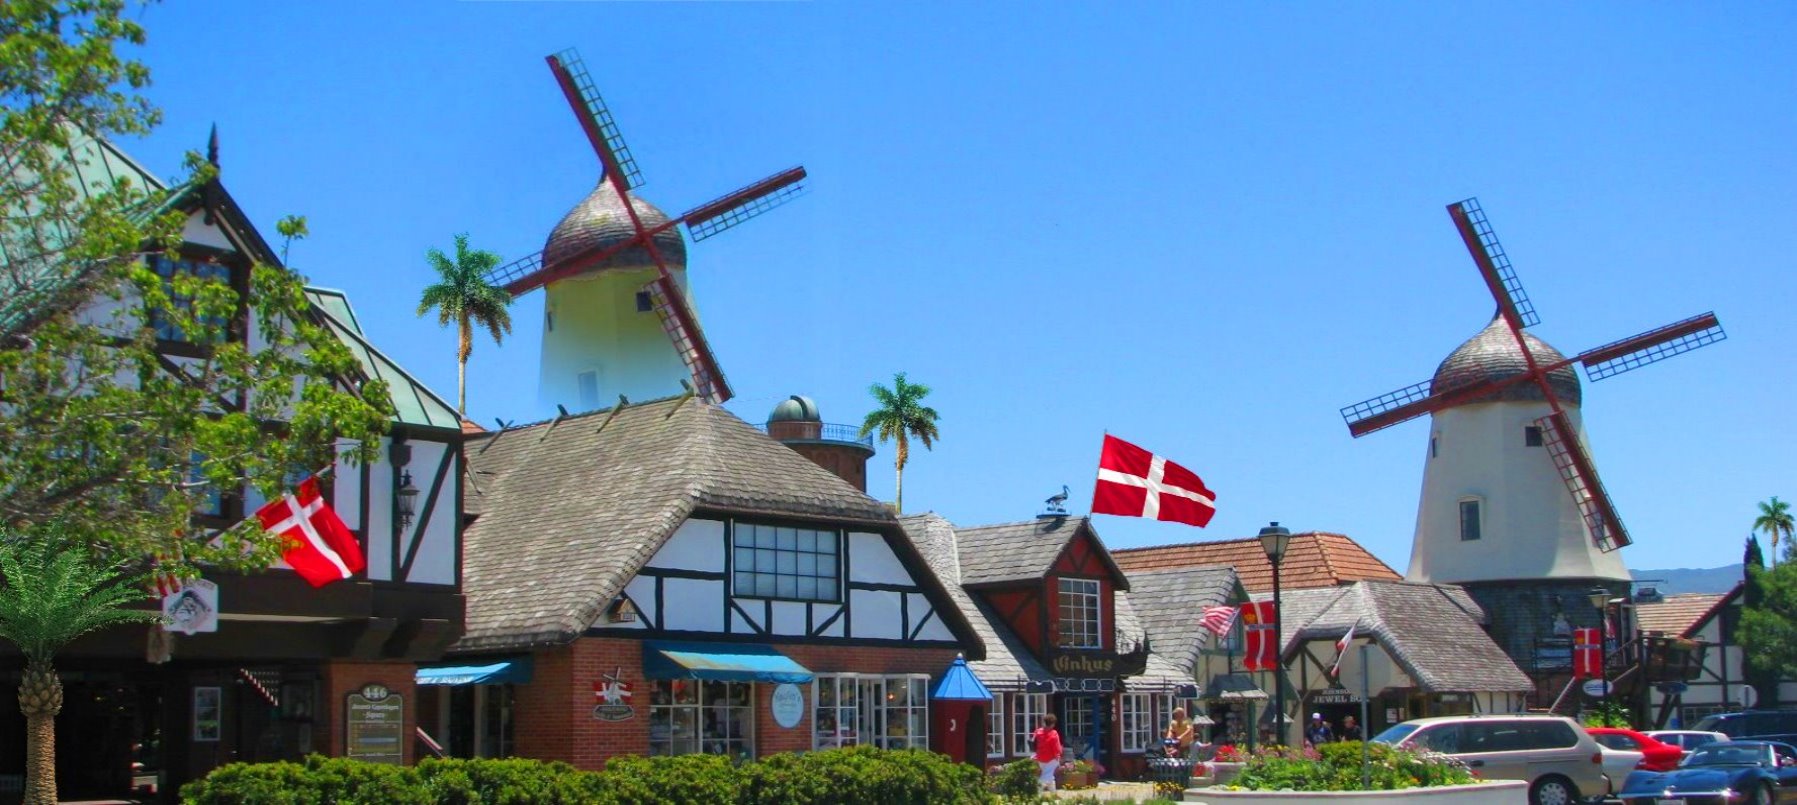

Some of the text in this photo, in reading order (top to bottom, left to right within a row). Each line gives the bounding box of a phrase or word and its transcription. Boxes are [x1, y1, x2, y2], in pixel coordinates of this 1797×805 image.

[363, 687, 387, 698] 446
[1312, 695, 1370, 703] JEWEL BO
